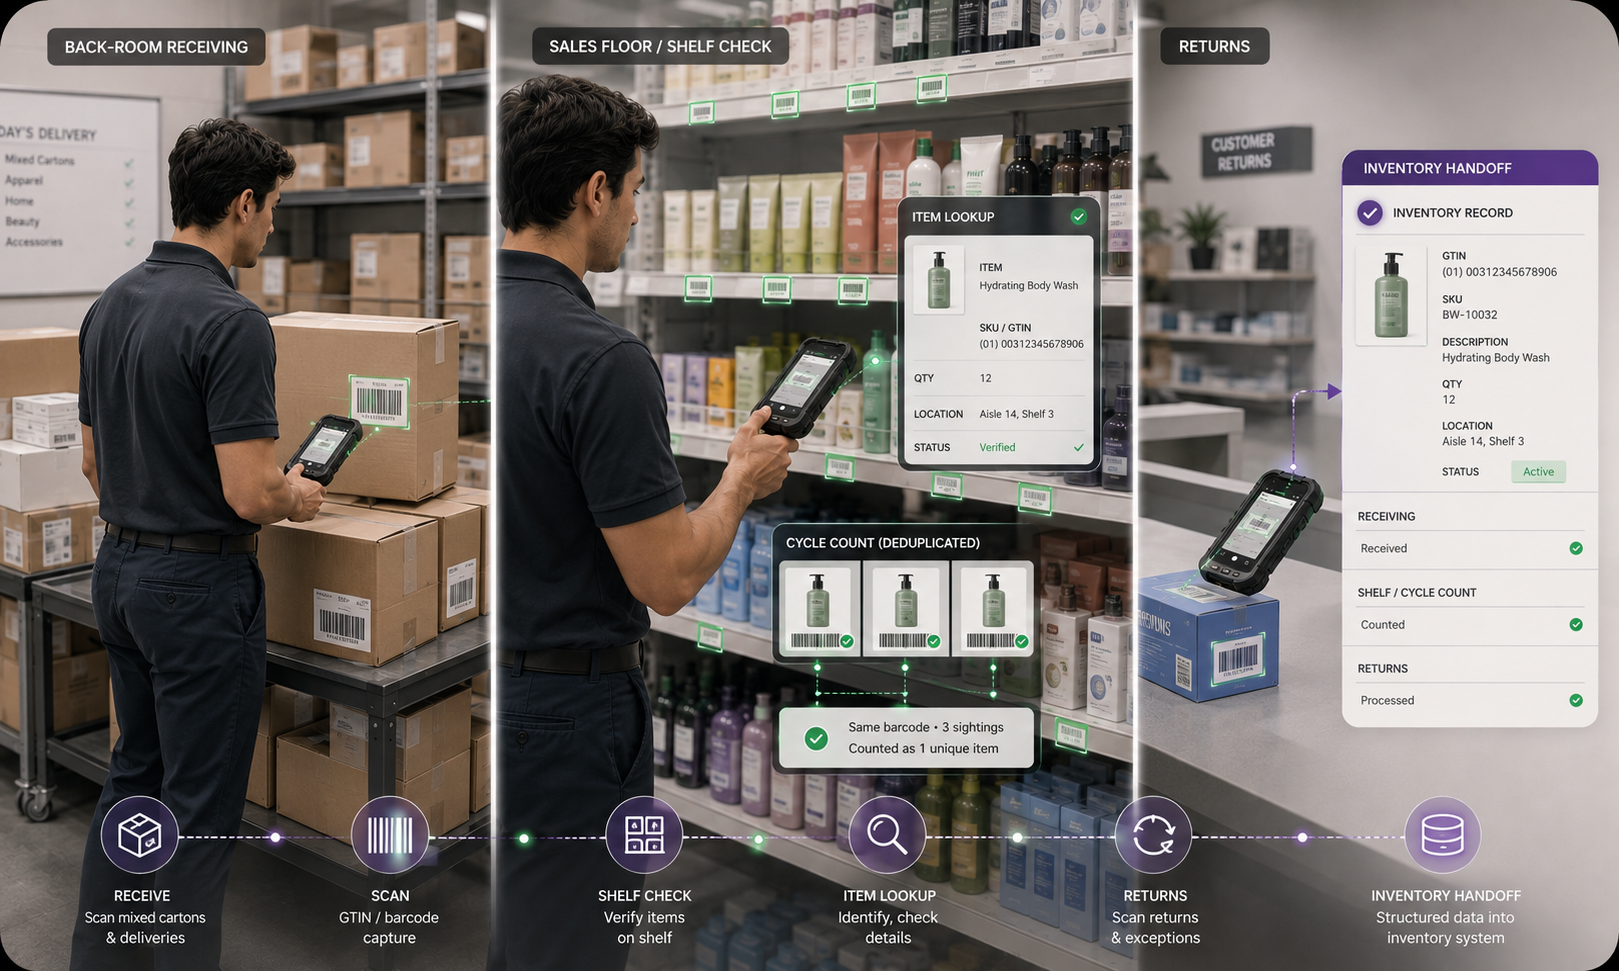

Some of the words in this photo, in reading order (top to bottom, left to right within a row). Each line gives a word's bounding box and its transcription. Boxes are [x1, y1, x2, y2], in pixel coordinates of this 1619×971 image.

[39, 127, 97, 141] DELIVERY
[1211, 132, 1275, 153] CUSTOMER
[5, 154, 34, 165] Mixed
[37, 155, 75, 166] Cartons
[1217, 153, 1272, 172] RETURNS
[5, 175, 43, 187] Apparel
[5, 196, 34, 206] Home
[5, 216, 40, 229] Beauty
[5, 236, 63, 247] Accessories
